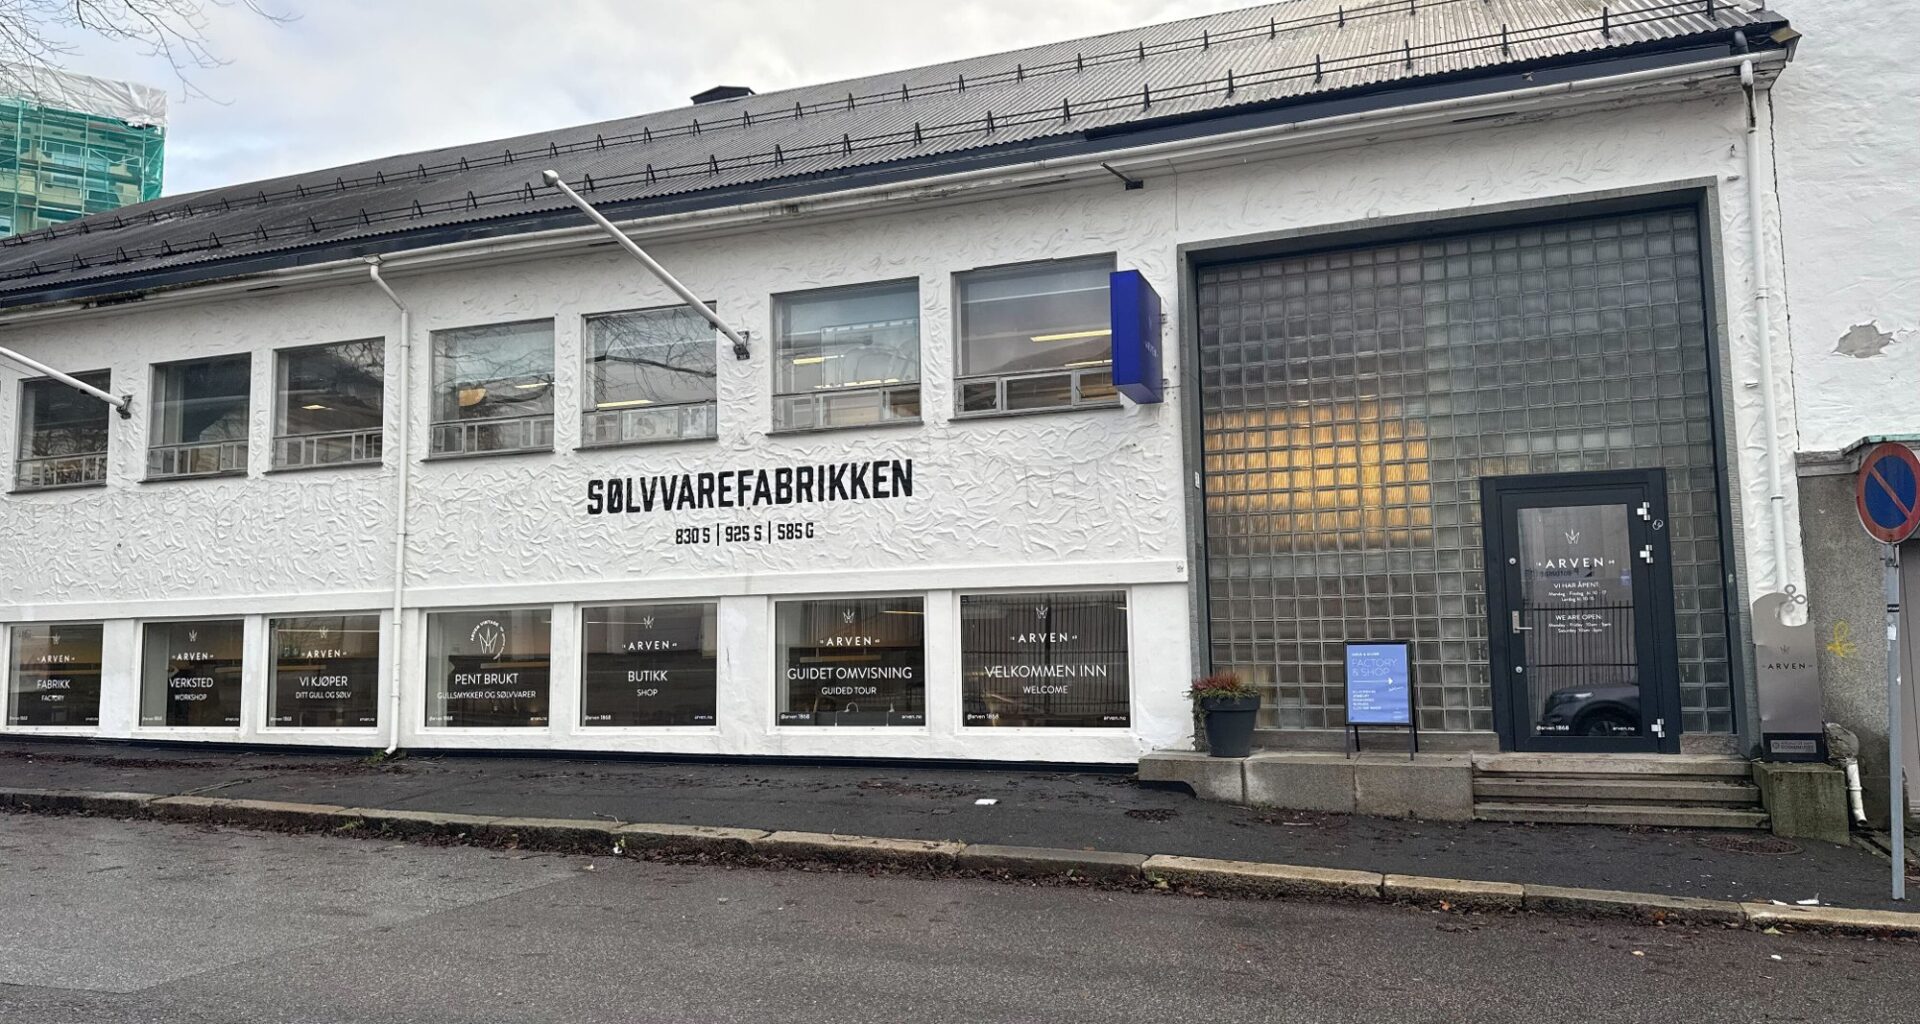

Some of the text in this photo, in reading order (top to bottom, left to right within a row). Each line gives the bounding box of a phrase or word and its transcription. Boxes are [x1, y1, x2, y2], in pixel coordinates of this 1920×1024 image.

[587, 459, 913, 515] SØLVVAREFABRIKKEN
[675, 527, 699, 544] 830
[702, 527, 710, 543] S
[725, 526, 750, 542] 925
[754, 525, 762, 541] S
[777, 524, 802, 540] 585
[805, 522, 814, 539] G
[1545, 557, 1603, 568] ARVEN
[826, 636, 872, 646] ARVEN
[1018, 632, 1068, 643] ARVEN
[628, 641, 670, 650] ARVEN
[176, 652, 209, 661] ARVEN
[306, 649, 341, 658] ARVEN
[40, 655, 70, 663] ARVEN
[1352, 658, 1398, 667] FACTORY
[787, 667, 912, 680] GUIDET OMVISNING
[985, 665, 1106, 678] VELKOMMEN INN
[1361, 668, 1389, 676] SHOP
[299, 676, 348, 686] VI KJØPER
[455, 673, 519, 685] PENT BRUKT
[628, 671, 668, 682] BUTIKK
[37, 680, 70, 689] FABRIKK
[169, 678, 213, 688] VERKSTED
[637, 689, 658, 697] SHOP
[821, 687, 877, 695] GUIDED TOUR
[1023, 685, 1068, 694] WELCOME
[437, 691, 483, 699] GULLSMYKKER
